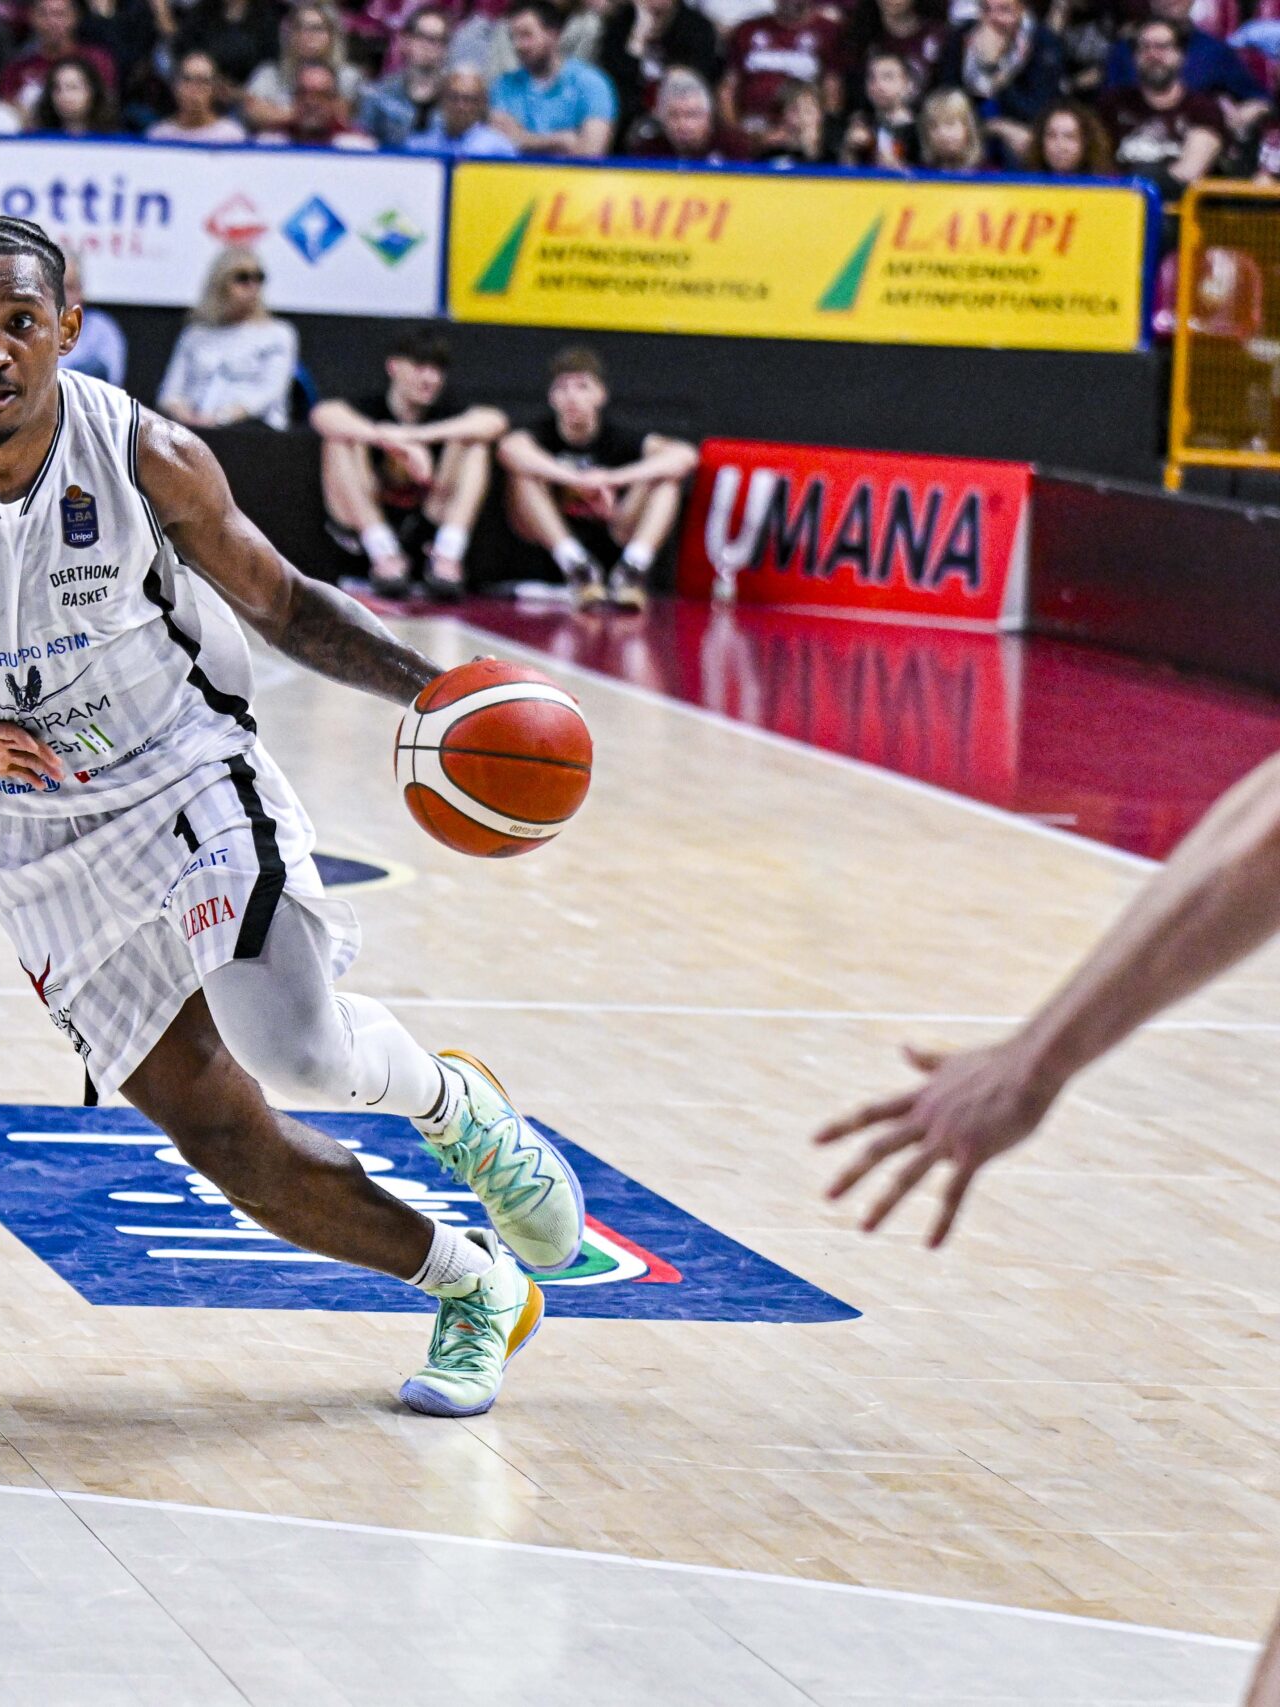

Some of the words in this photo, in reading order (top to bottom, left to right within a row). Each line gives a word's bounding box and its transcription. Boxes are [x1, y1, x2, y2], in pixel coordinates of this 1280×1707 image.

[543, 191, 731, 243] LAMPI
[890, 205, 1080, 257] LAMPI
[66, 510, 93, 523] LBA
[705, 464, 984, 595] UMANA
[71, 531, 93, 542] Unipol
[49, 565, 120, 588] DERTHONA
[61, 586, 108, 607] BASKET
[46, 632, 90, 658] ASTM
[172, 810, 201, 854] 1
